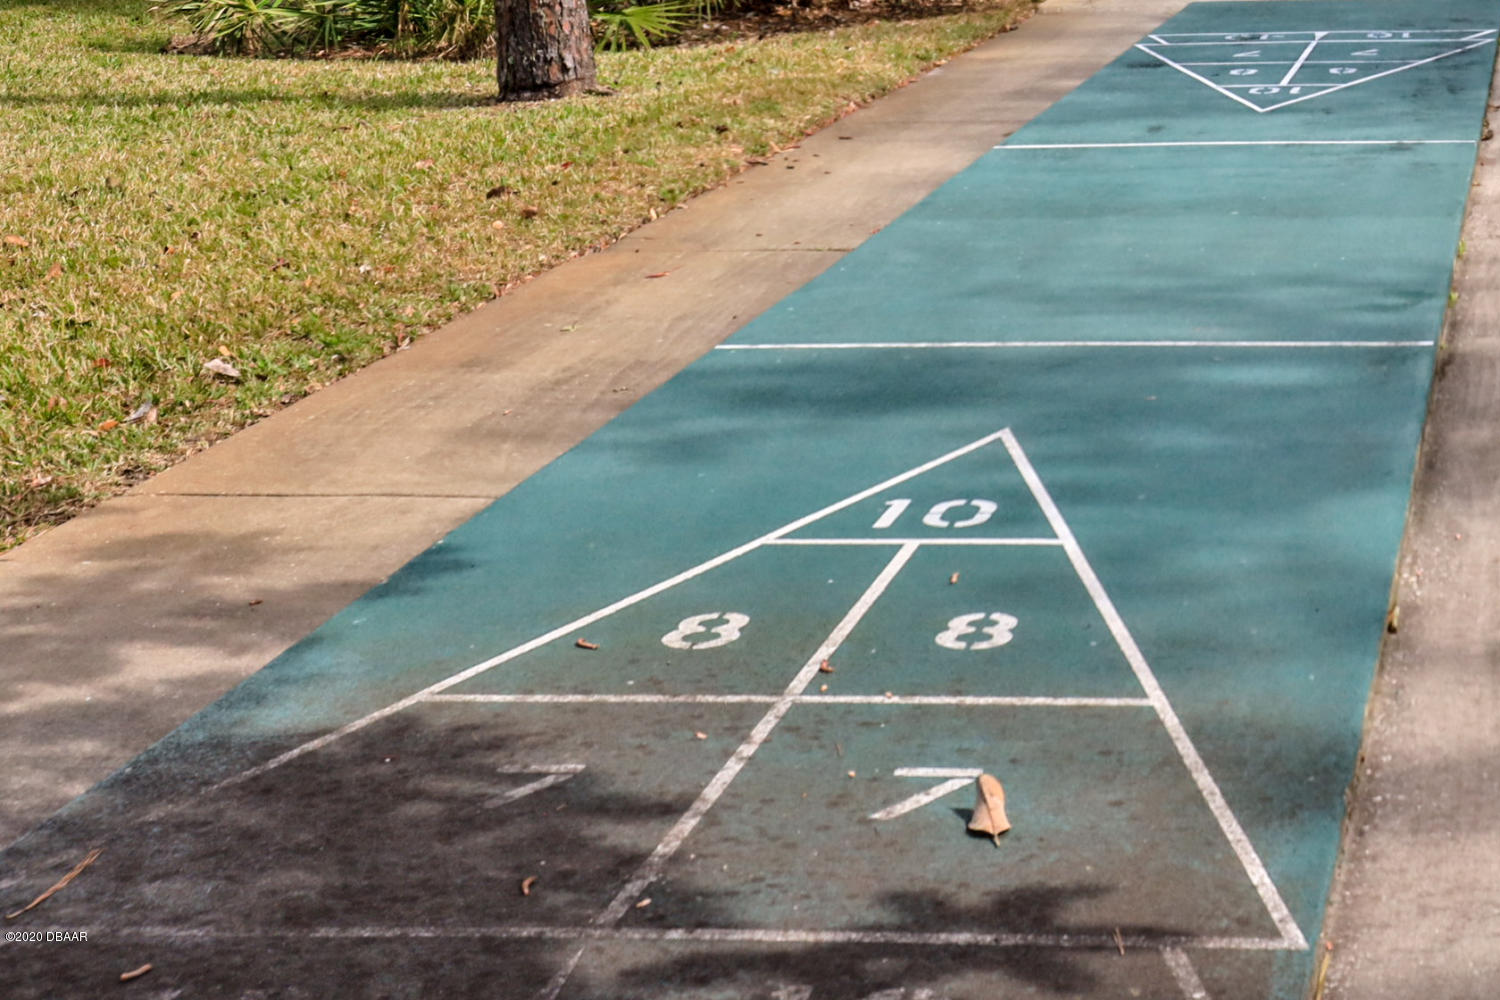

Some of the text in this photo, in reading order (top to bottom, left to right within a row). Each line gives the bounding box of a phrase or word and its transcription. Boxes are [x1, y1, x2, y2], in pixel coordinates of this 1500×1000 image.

[1248, 86, 1301, 95] 10
[872, 498, 998, 529] 10
[661, 612, 752, 650] 8
[935, 612, 1018, 651] 8
[480, 764, 586, 809] 7
[869, 767, 984, 820] 7
